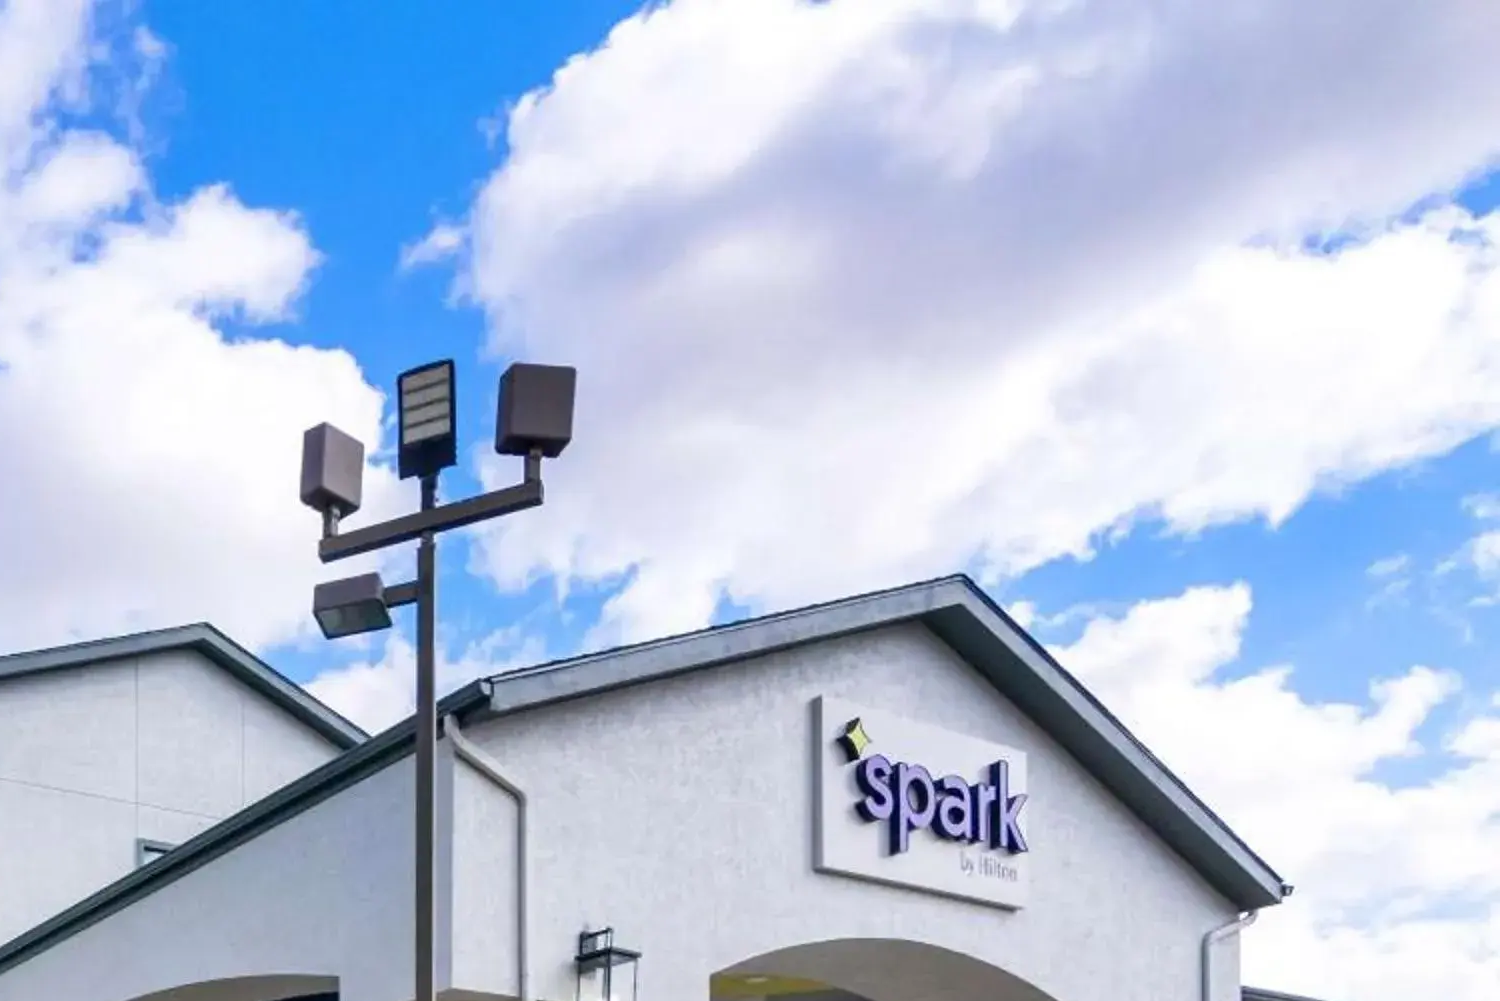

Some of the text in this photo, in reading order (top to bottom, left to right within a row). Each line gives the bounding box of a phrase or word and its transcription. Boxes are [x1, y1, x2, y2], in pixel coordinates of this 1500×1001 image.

[855, 754, 1029, 856] spark
[960, 850, 1018, 881] by Hilton
